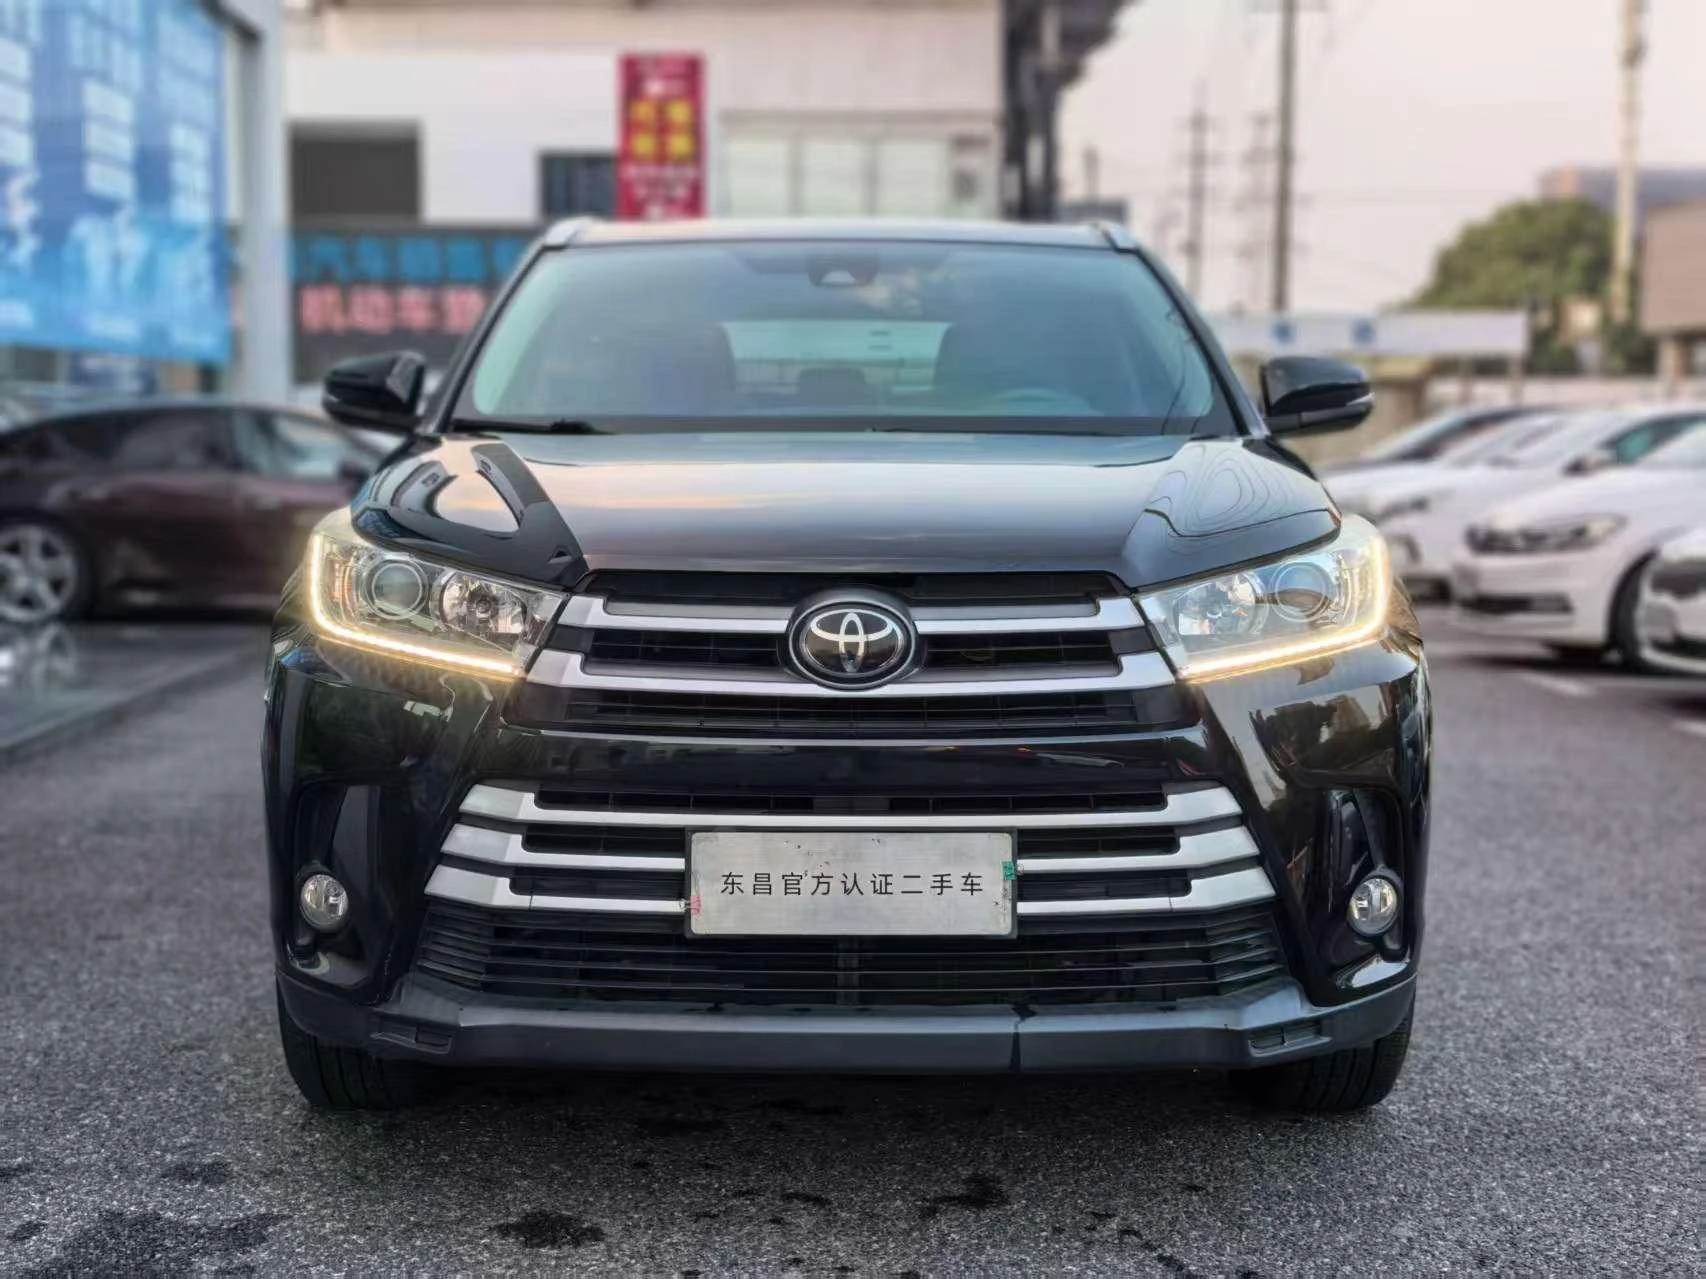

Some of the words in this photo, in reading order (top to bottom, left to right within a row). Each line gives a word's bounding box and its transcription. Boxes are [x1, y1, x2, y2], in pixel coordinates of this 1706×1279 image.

[720, 871, 983, 896] 东昌官方认证二手车
